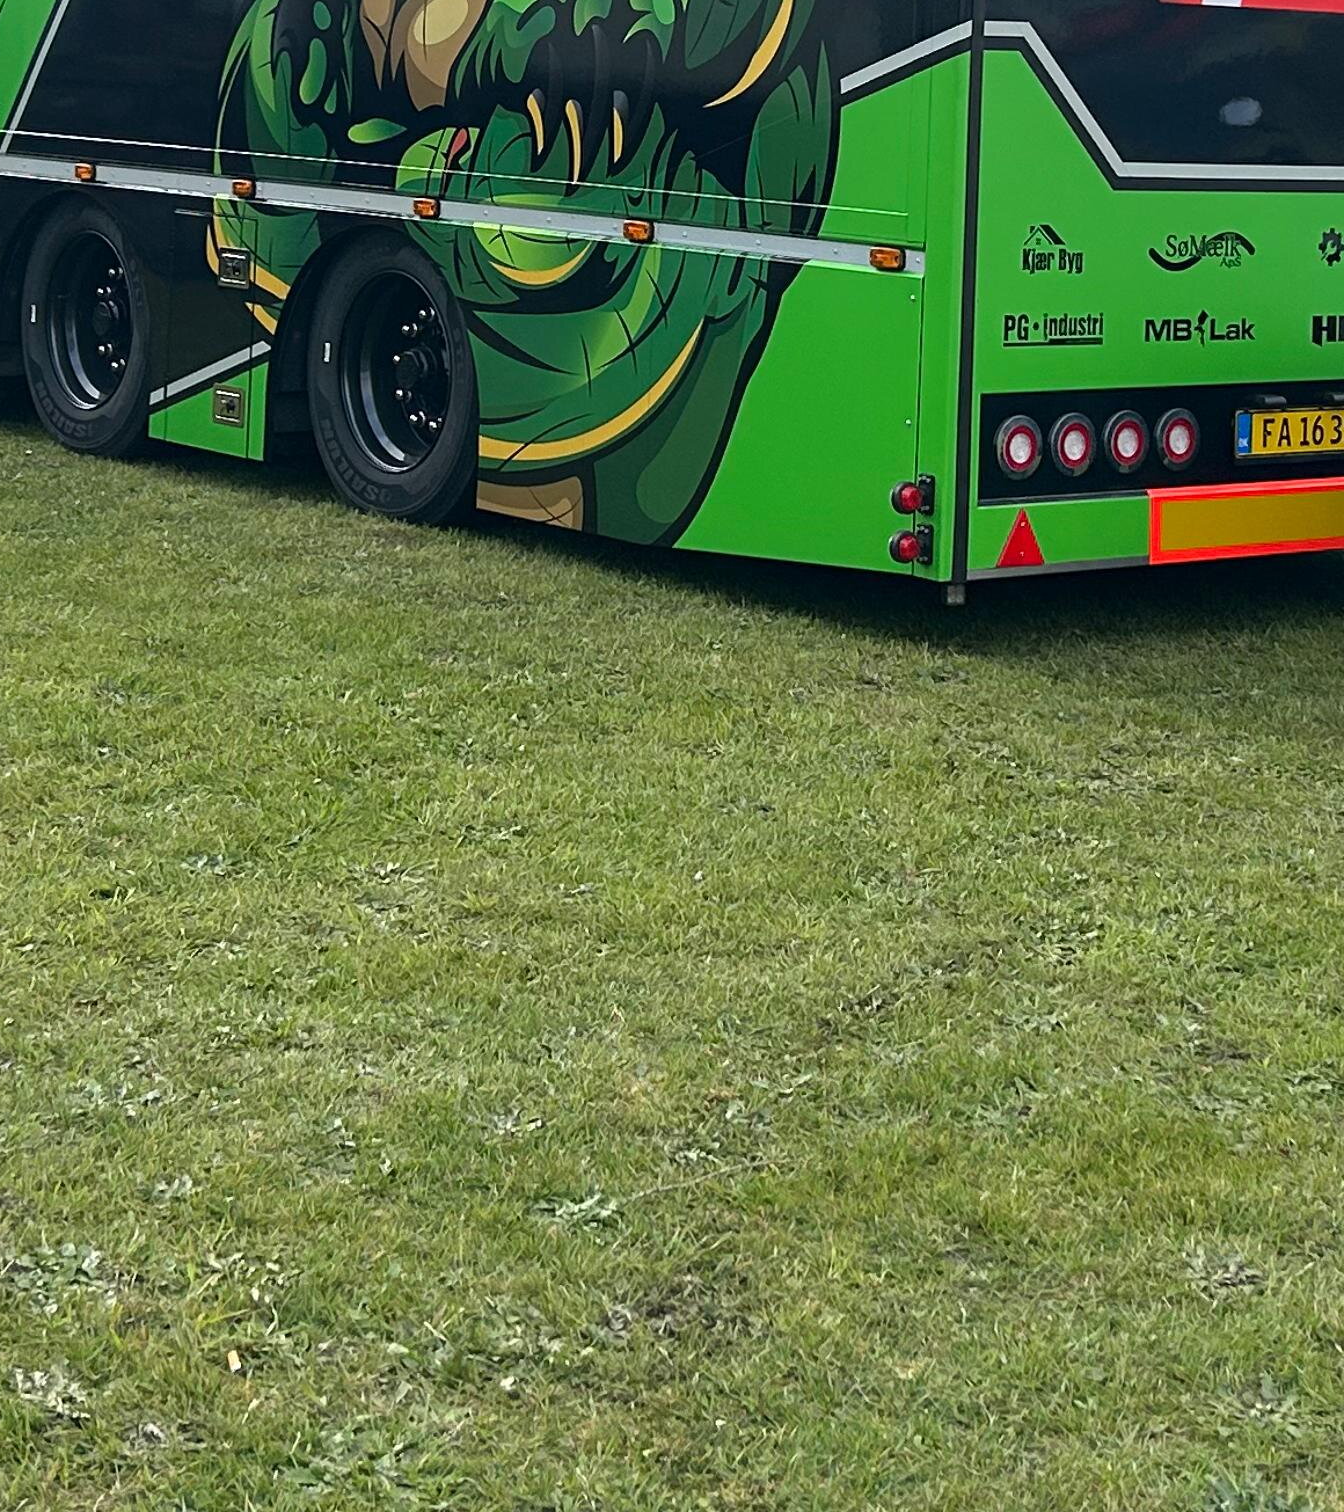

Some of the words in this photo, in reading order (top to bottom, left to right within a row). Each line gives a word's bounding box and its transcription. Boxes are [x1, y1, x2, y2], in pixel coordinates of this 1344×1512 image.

[1022, 248, 1055, 274] Kjær
[1058, 248, 1083, 274] Byg
[1003, 313, 1030, 341] PG
[1043, 312, 1103, 340] industri
[1144, 318, 1192, 342] MB
[1209, 317, 1256, 341] Lak
[1262, 417, 1292, 447] FA
[1300, 415, 1324, 446] 16
